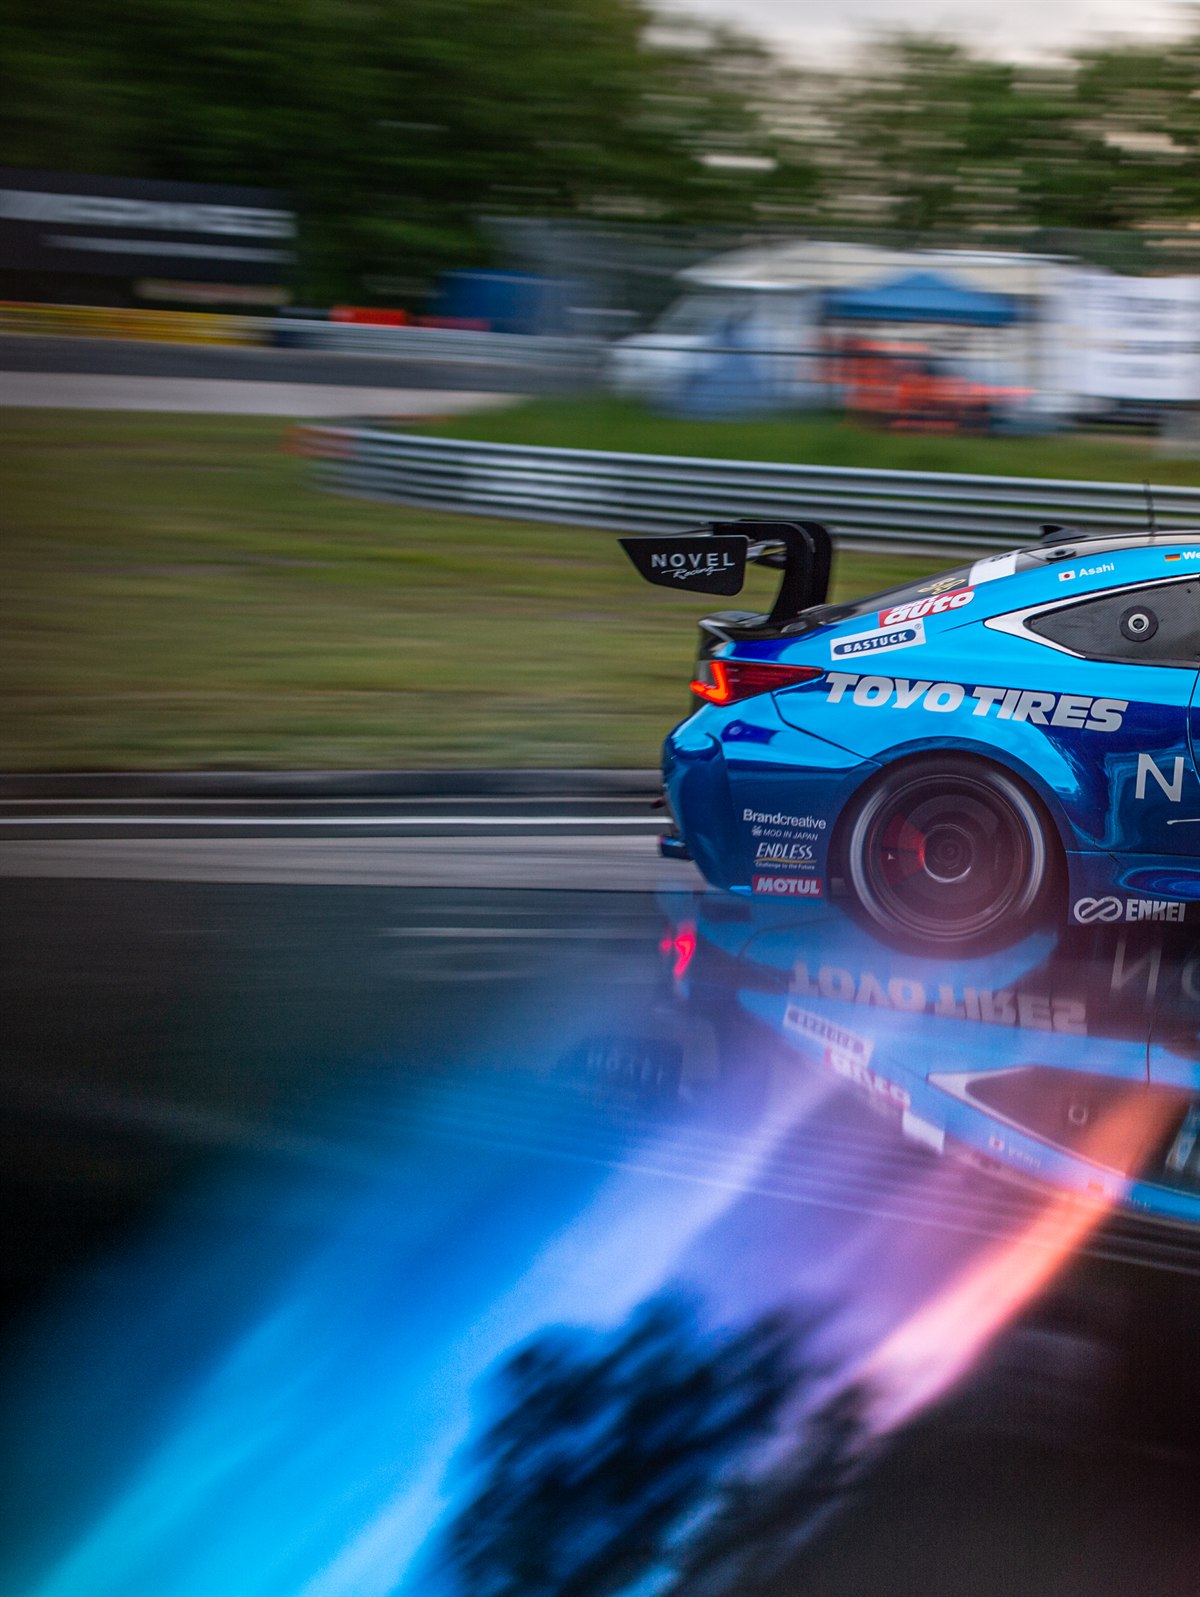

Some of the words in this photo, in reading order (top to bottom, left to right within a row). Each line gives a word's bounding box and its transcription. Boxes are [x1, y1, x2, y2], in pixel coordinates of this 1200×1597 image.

[651, 552, 735, 568] NOVEL
[661, 566, 727, 580] Racing
[1079, 562, 1115, 578] Asahi
[884, 590, 975, 626] auto
[843, 631, 908, 654] BASTUCK
[825, 672, 966, 713] TOYO
[972, 686, 1129, 733] TIRES
[742, 808, 827, 830] Brandcreative
[763, 828, 782, 838] MOD
[783, 830, 793, 839] IN
[793, 831, 819, 842] JAPAN
[756, 842, 813, 861] ENDLESS
[756, 877, 820, 895] MOTUL
[1126, 899, 1186, 922] ENKEI
